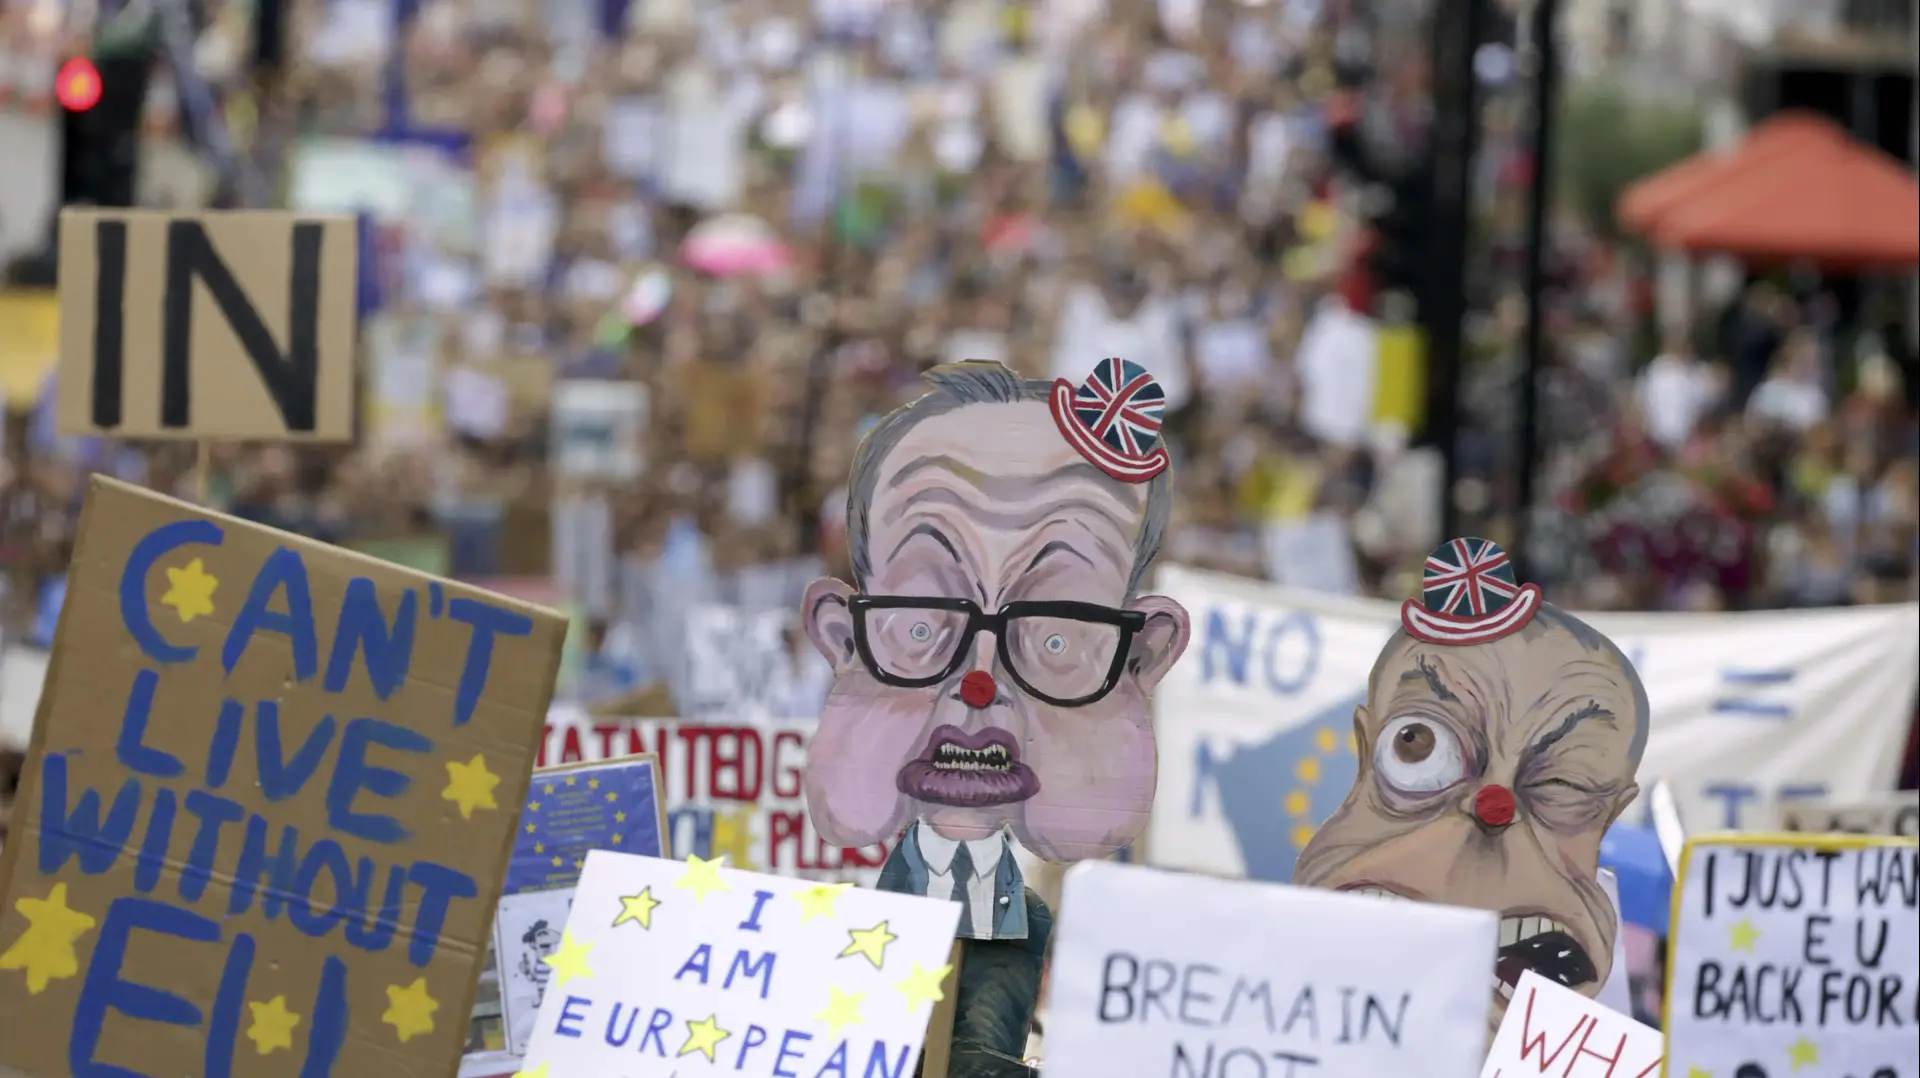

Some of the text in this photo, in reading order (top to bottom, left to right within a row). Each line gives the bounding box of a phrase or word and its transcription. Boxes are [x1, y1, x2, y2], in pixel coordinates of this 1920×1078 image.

[91, 220, 323, 431] IN
[119, 519, 533, 726] CAN'T
[1203, 607, 1321, 693] NO
[115, 669, 435, 844] LIVE
[38, 751, 478, 968] WITHOUT
[1729, 849, 1842, 910] JUST
[737, 890, 774, 931] I
[68, 897, 349, 1078] EU
[673, 943, 777, 999] AM
[1097, 951, 1411, 1047] BREMAIN
[1694, 962, 1803, 1024] BACK
[1819, 970, 1903, 1029] FOR
[554, 995, 911, 1078] EURPEAN
